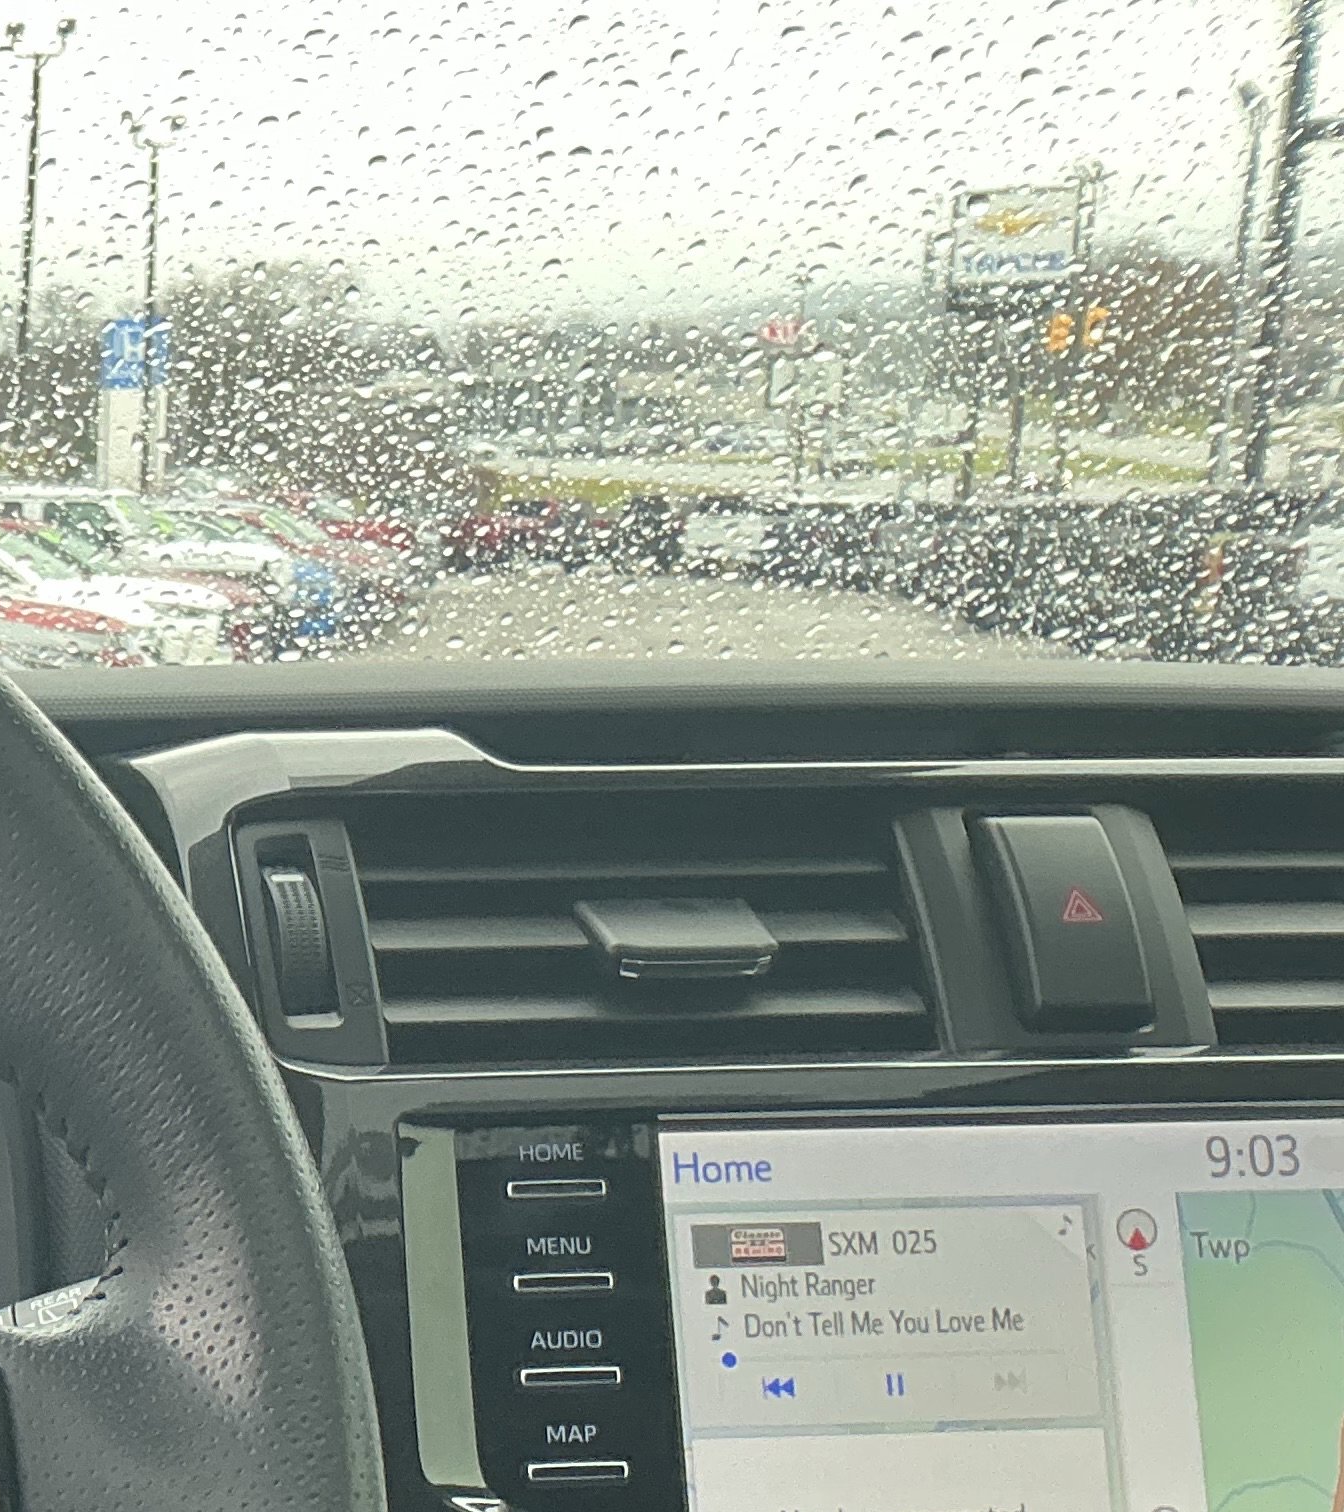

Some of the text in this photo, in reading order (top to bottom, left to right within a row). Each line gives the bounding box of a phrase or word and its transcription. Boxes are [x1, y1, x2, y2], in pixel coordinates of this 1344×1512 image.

[518, 1143, 584, 1162] HOME
[1205, 1134, 1301, 1178] 9:03
[672, 1152, 773, 1185] Home
[525, 1237, 592, 1256] MENU
[828, 1229, 937, 1256] SXM 025
[1190, 1232, 1251, 1264] Twp
[1134, 1255, 1148, 1277] S
[30, 1286, 82, 1311] REAR
[741, 1271, 876, 1303] Night Ranger
[744, 1307, 1025, 1339] Don't Tell Me You Love Me
[530, 1330, 602, 1350] AUDIO
[546, 1424, 597, 1444] MAP
